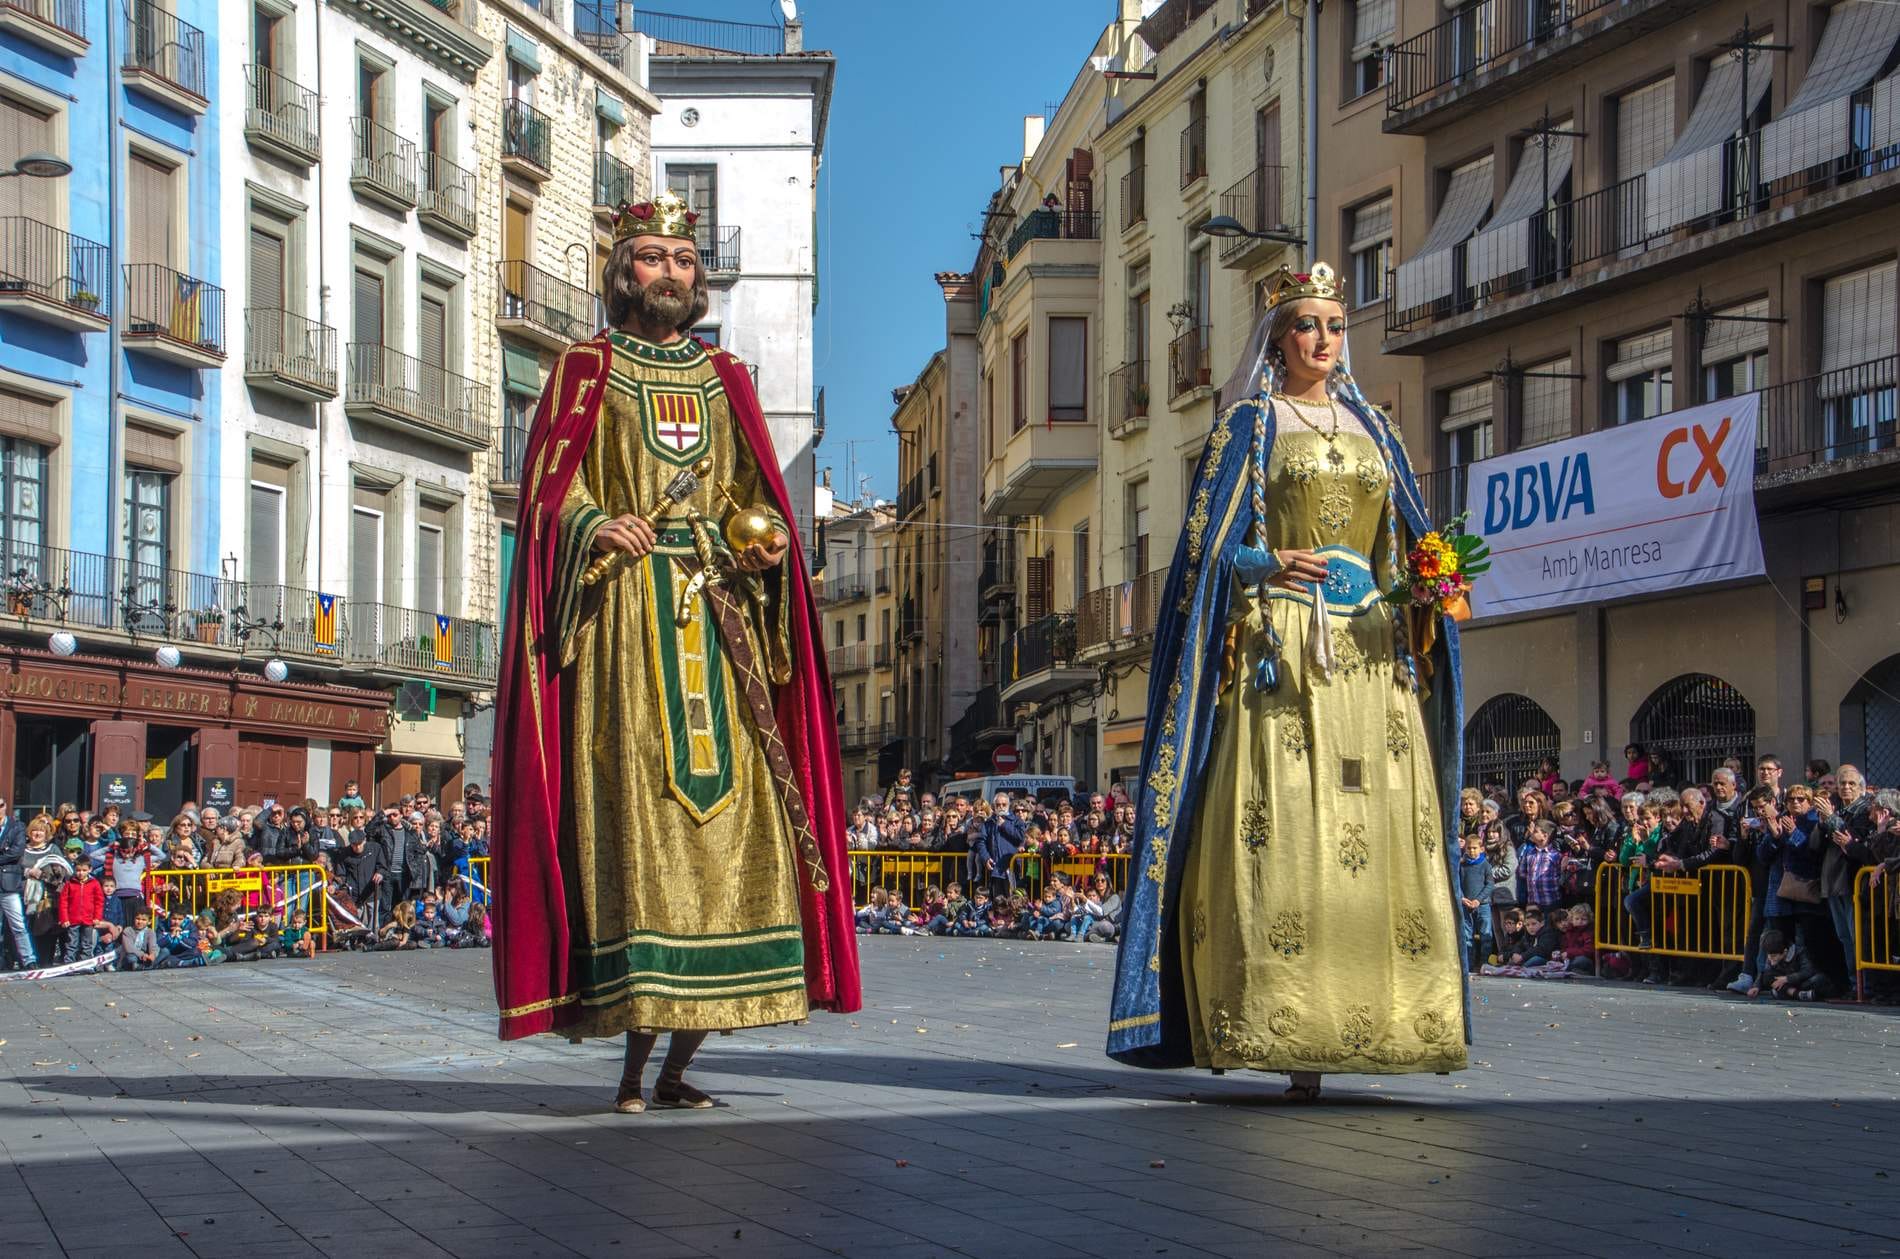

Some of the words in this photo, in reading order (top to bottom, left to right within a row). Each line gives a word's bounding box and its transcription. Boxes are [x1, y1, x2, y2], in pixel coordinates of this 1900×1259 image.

[1484, 452, 1595, 535] BBVA
[1656, 417, 1731, 499] CX
[1542, 550, 1578, 580] Amb
[1584, 540, 1662, 570] Manresa
[10, 674, 128, 705] DROGUERIA
[140, 687, 211, 713] FERRER
